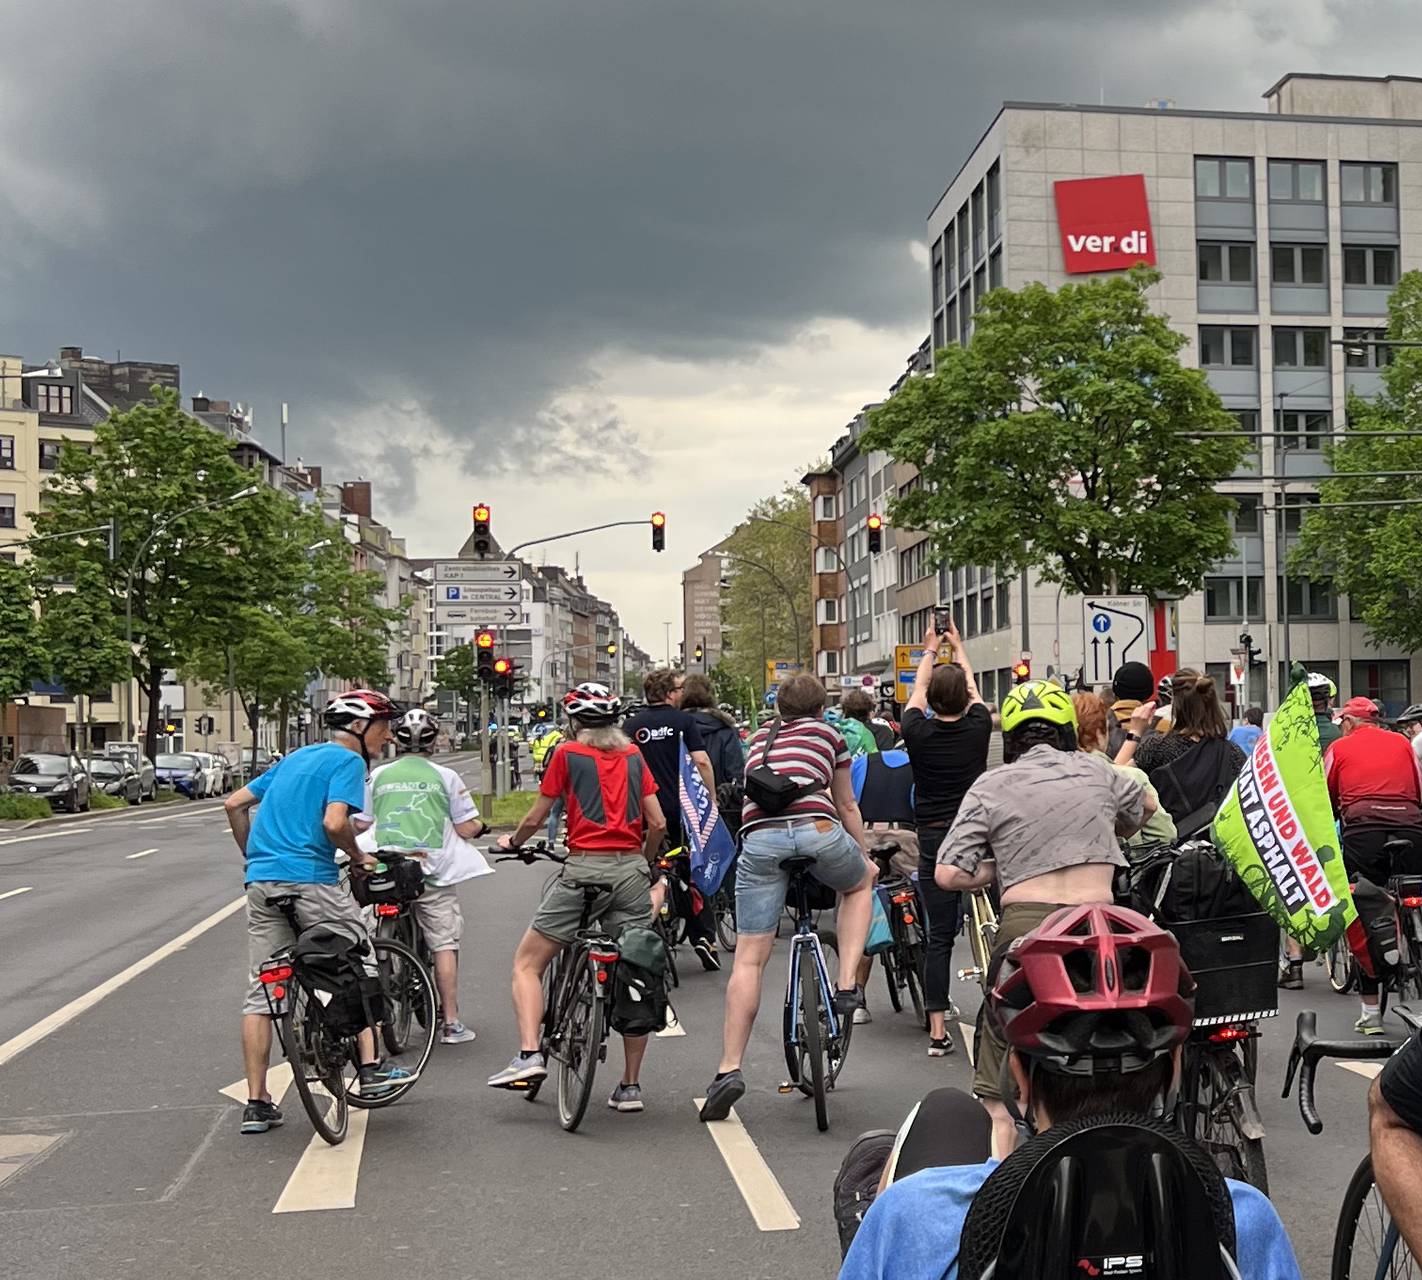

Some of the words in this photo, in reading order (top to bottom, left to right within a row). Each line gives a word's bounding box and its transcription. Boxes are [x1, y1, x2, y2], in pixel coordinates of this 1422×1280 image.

[1246, 808, 1306, 907] ASPHALT
[1267, 790, 1297, 840] UND
[1290, 840, 1332, 908] WALD
[1103, 1255, 1143, 1269] IPS
